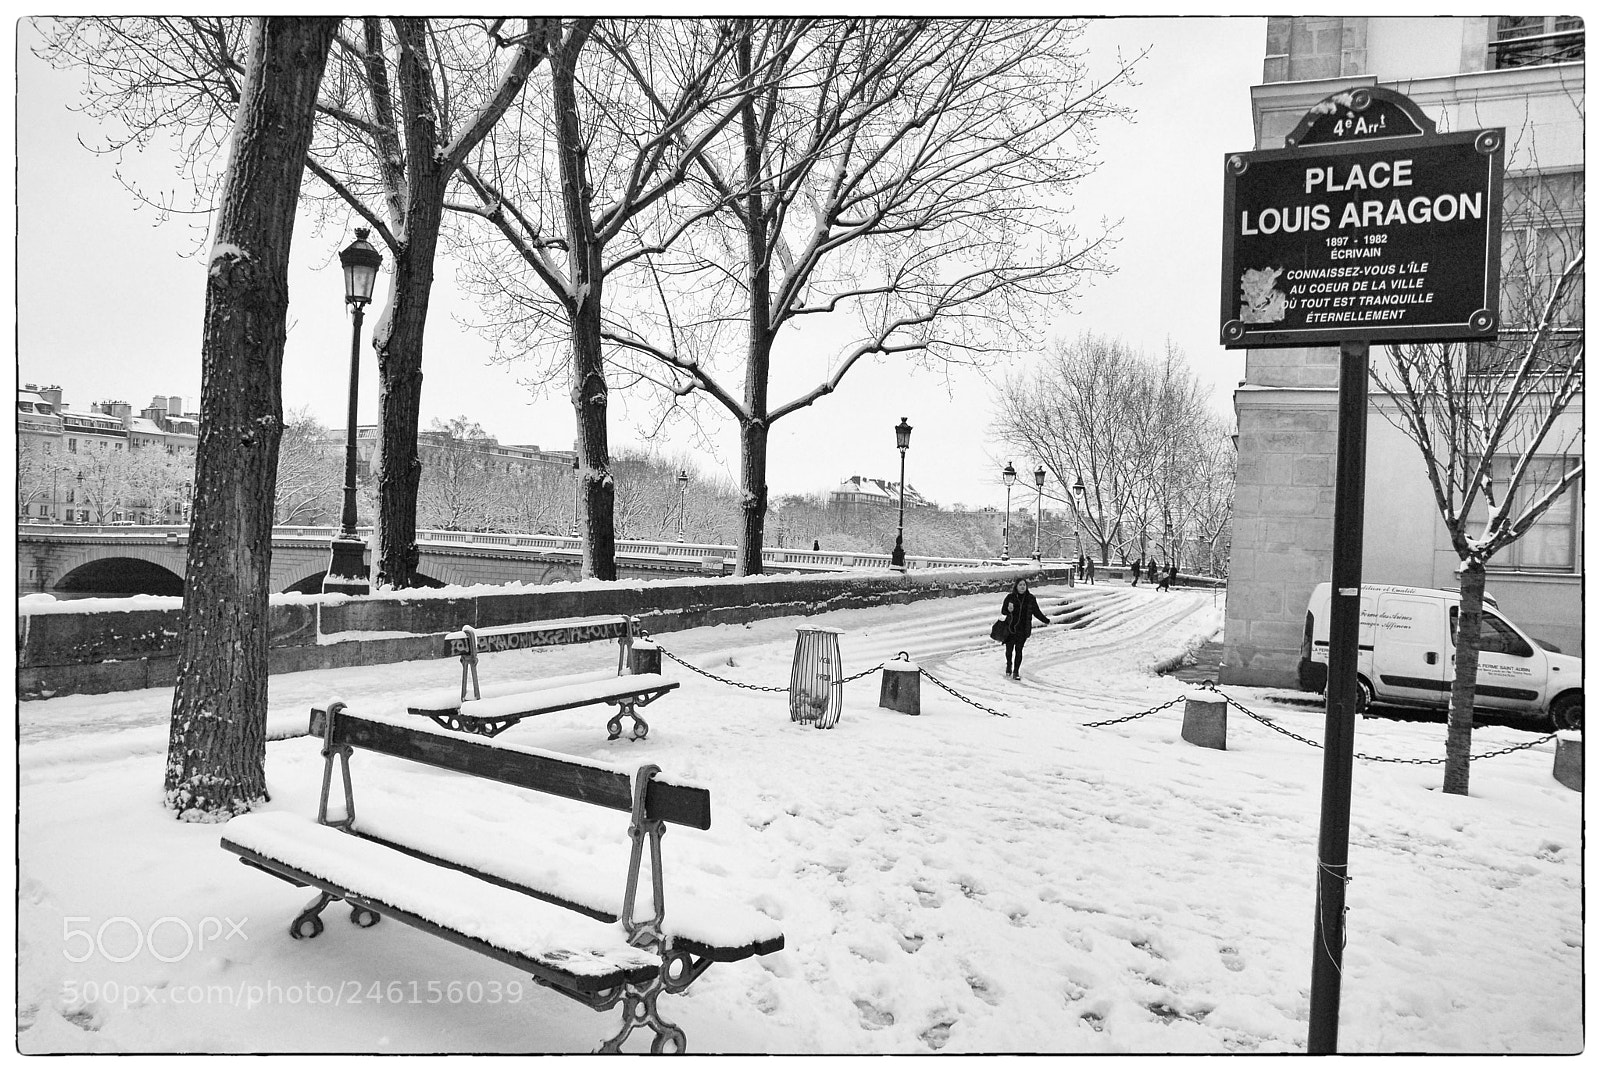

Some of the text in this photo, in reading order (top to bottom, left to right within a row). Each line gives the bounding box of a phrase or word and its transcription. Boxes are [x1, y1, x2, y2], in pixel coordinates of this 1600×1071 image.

[1305, 159, 1413, 194] PLACE
[1241, 192, 1482, 236] LOUIS ARAGON
[1325, 236, 1349, 247] 1897
[1363, 234, 1388, 245] 1982
[1330, 247, 1381, 260] ÉCRIVAIN
[1286, 261, 1429, 280] CONNAISSEZ-VOUS L'ÎLE
[1290, 278, 1424, 295] AU COEUR DE LA VILLE
[1301, 298, 1330, 309] TOUT
[1333, 297, 1354, 307] EST
[1359, 293, 1433, 306] TRANQUILLE
[1305, 309, 1406, 323] ÉTERNELLEMENT
